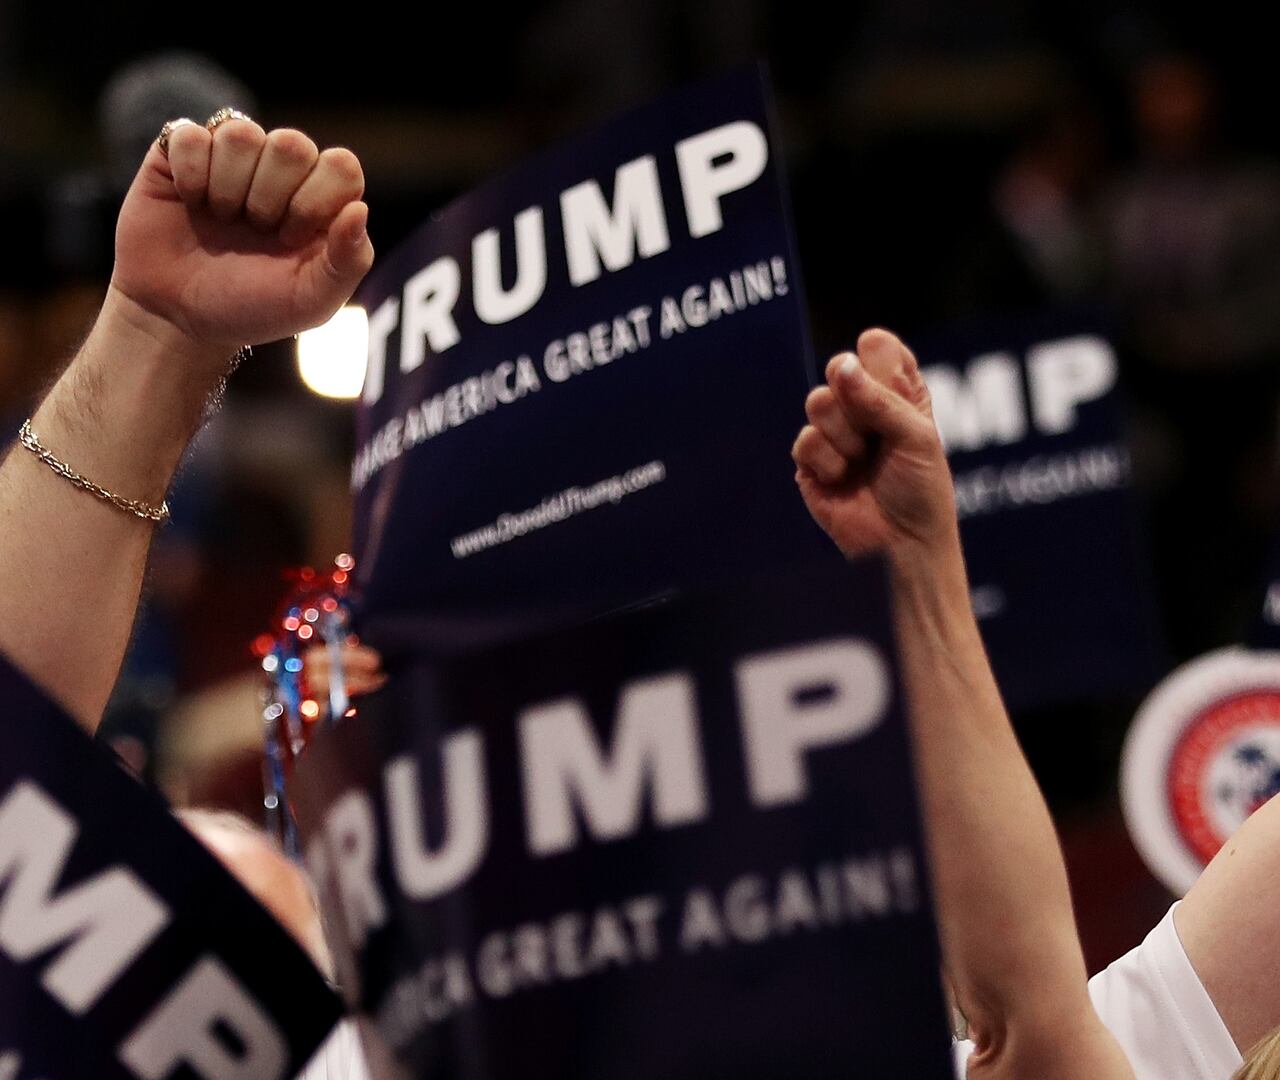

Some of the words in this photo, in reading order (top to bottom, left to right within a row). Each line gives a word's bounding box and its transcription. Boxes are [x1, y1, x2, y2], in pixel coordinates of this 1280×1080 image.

[400, 354, 542, 452] AMERICA
[543, 304, 653, 383] GREAT
[659, 255, 790, 340] AGAIN!
[478, 893, 661, 999] GREAT
[680, 846, 918, 954] AGAIN!
